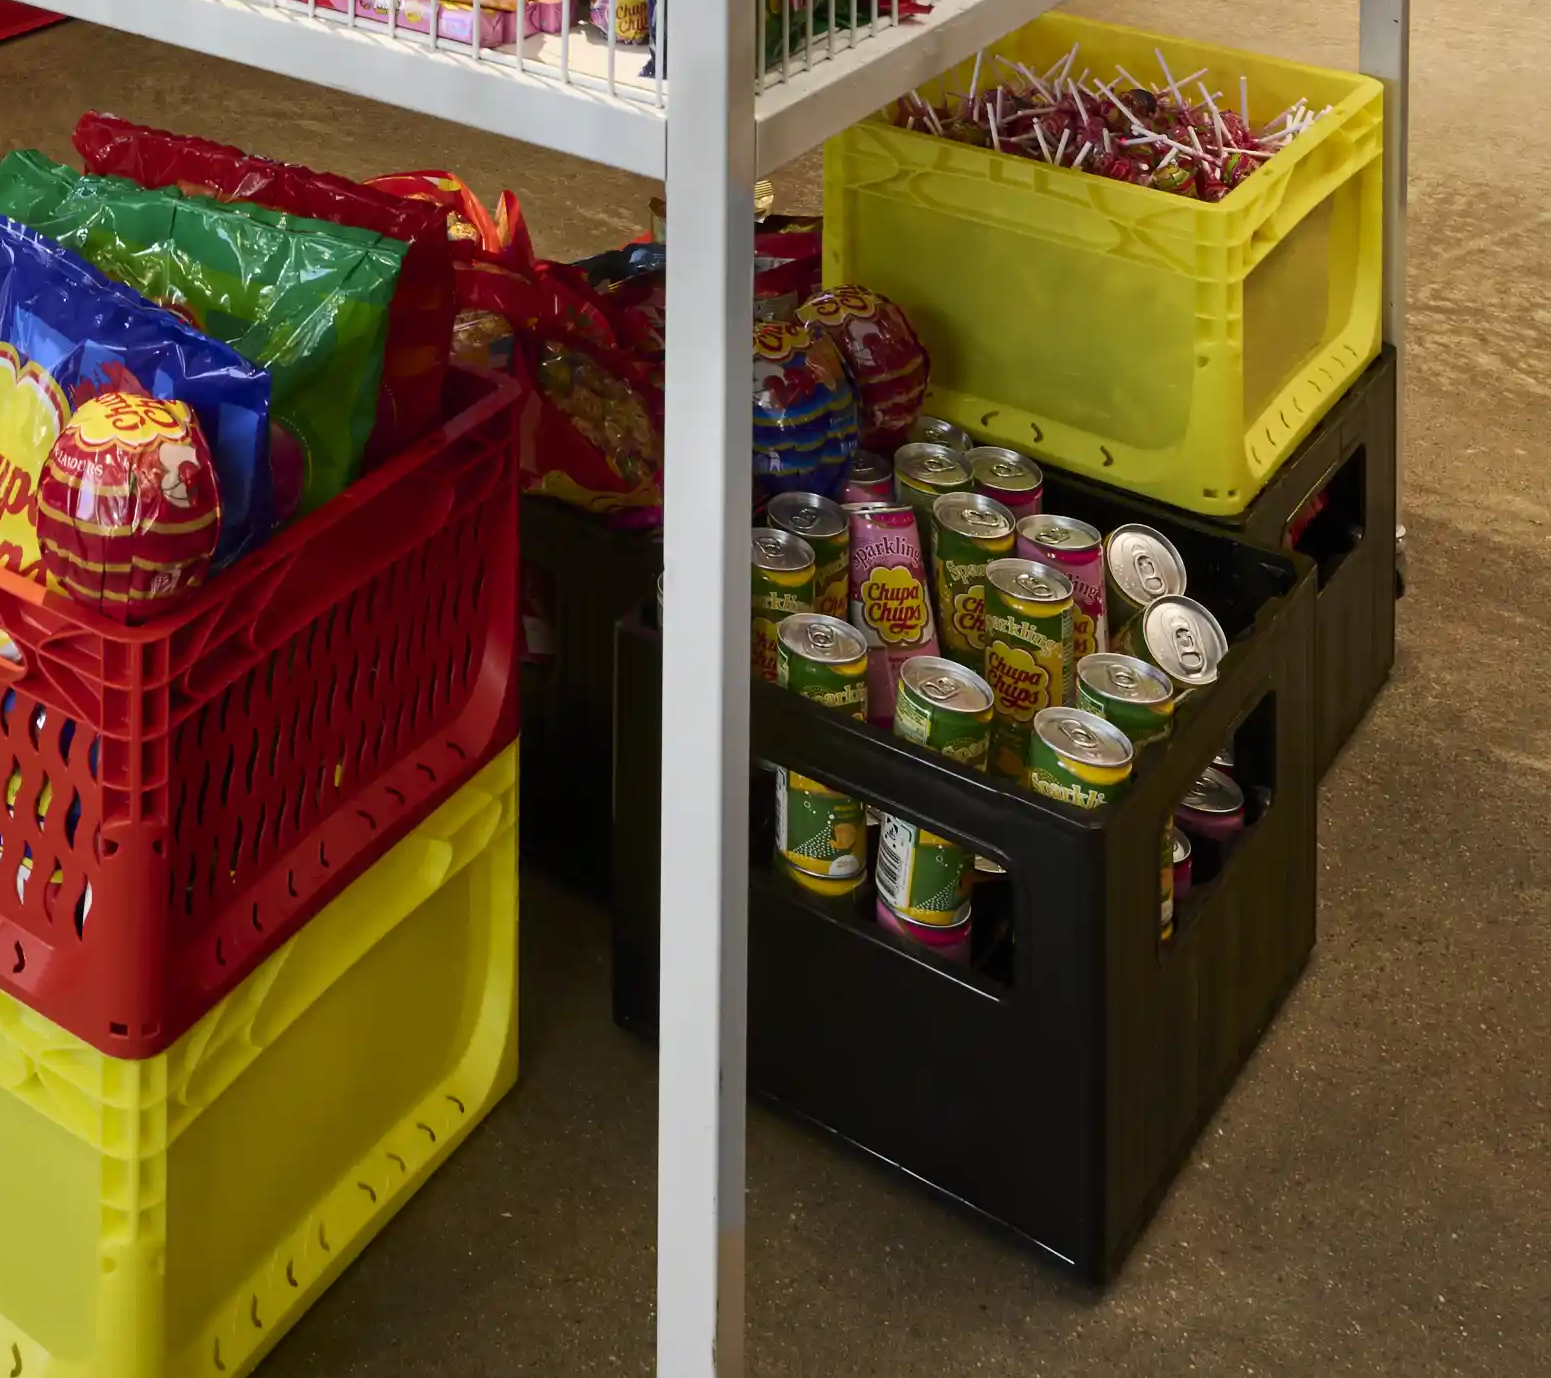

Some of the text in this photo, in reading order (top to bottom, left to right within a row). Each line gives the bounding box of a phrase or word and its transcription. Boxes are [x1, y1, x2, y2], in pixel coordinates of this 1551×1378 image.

[868, 582, 920, 607] Chupa
[866, 603, 922, 634] Chups
[988, 652, 1042, 688] Chupa
[988, 678, 1048, 715] Chups
